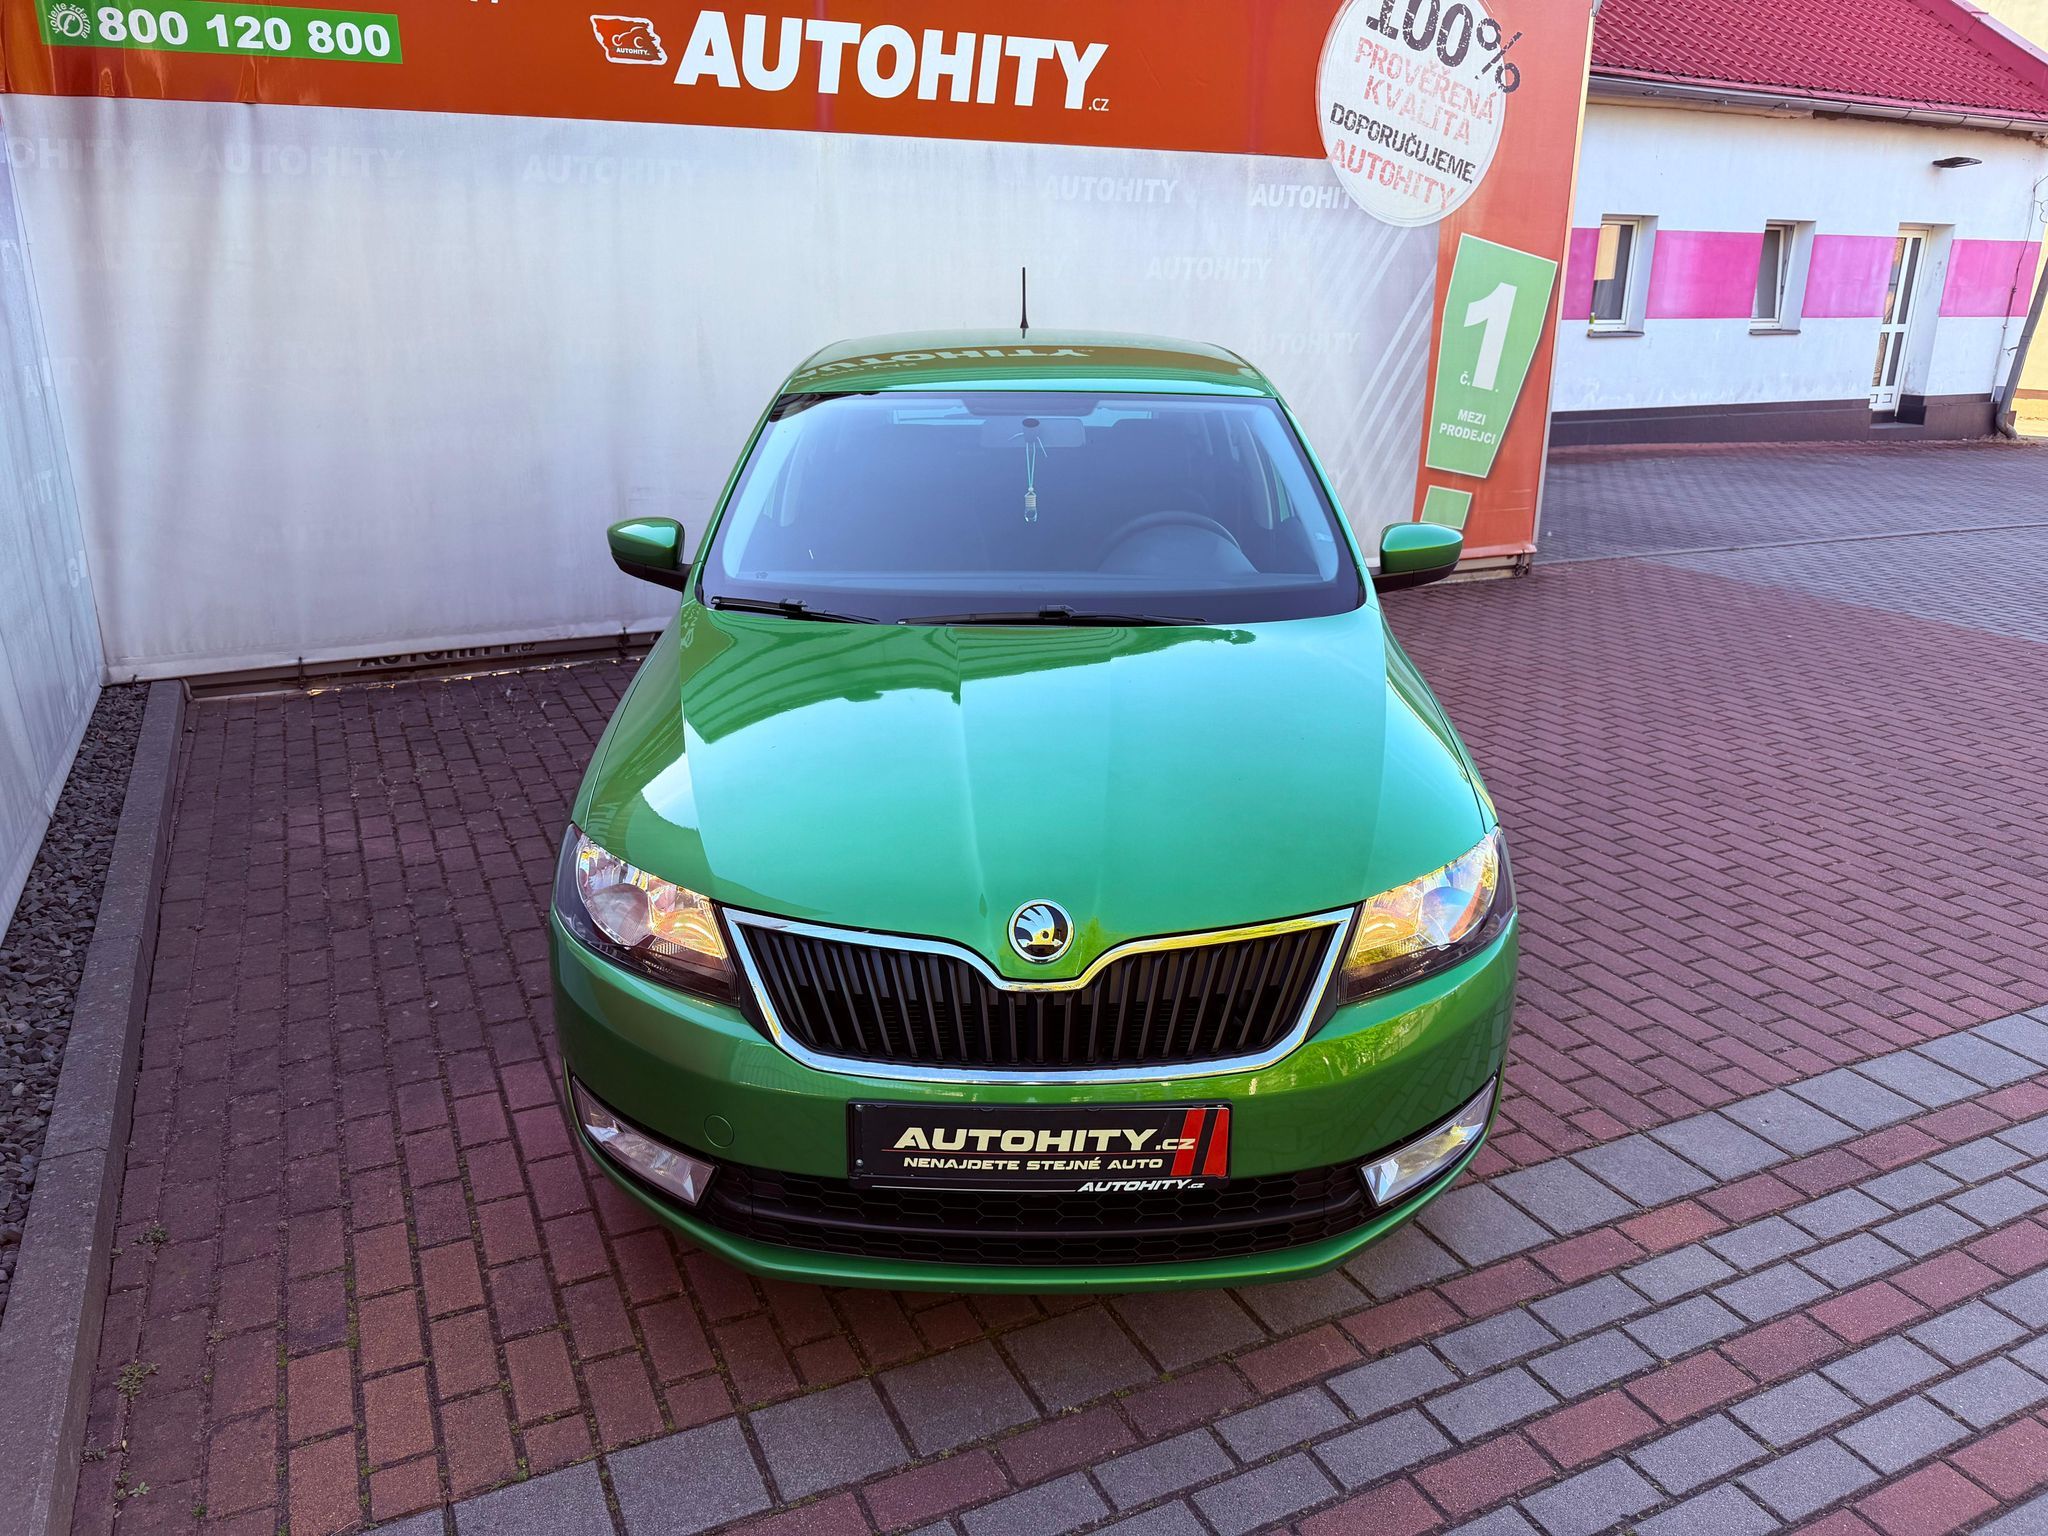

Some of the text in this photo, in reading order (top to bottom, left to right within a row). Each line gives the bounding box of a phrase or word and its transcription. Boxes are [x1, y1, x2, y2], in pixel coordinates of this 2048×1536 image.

[97, 6, 390, 57] 800 120 800
[1362, 74, 1471, 146] KVALITA
[1329, 101, 1477, 184] DOPORUČUJEME
[1329, 139, 1456, 210] AUTOHITY
[1439, 423, 1496, 446] PRODEJCI
[1457, 409, 1486, 425] MEZI
[903, 1154, 1164, 1171] NENAJDETE STEJNÉ AUTO
